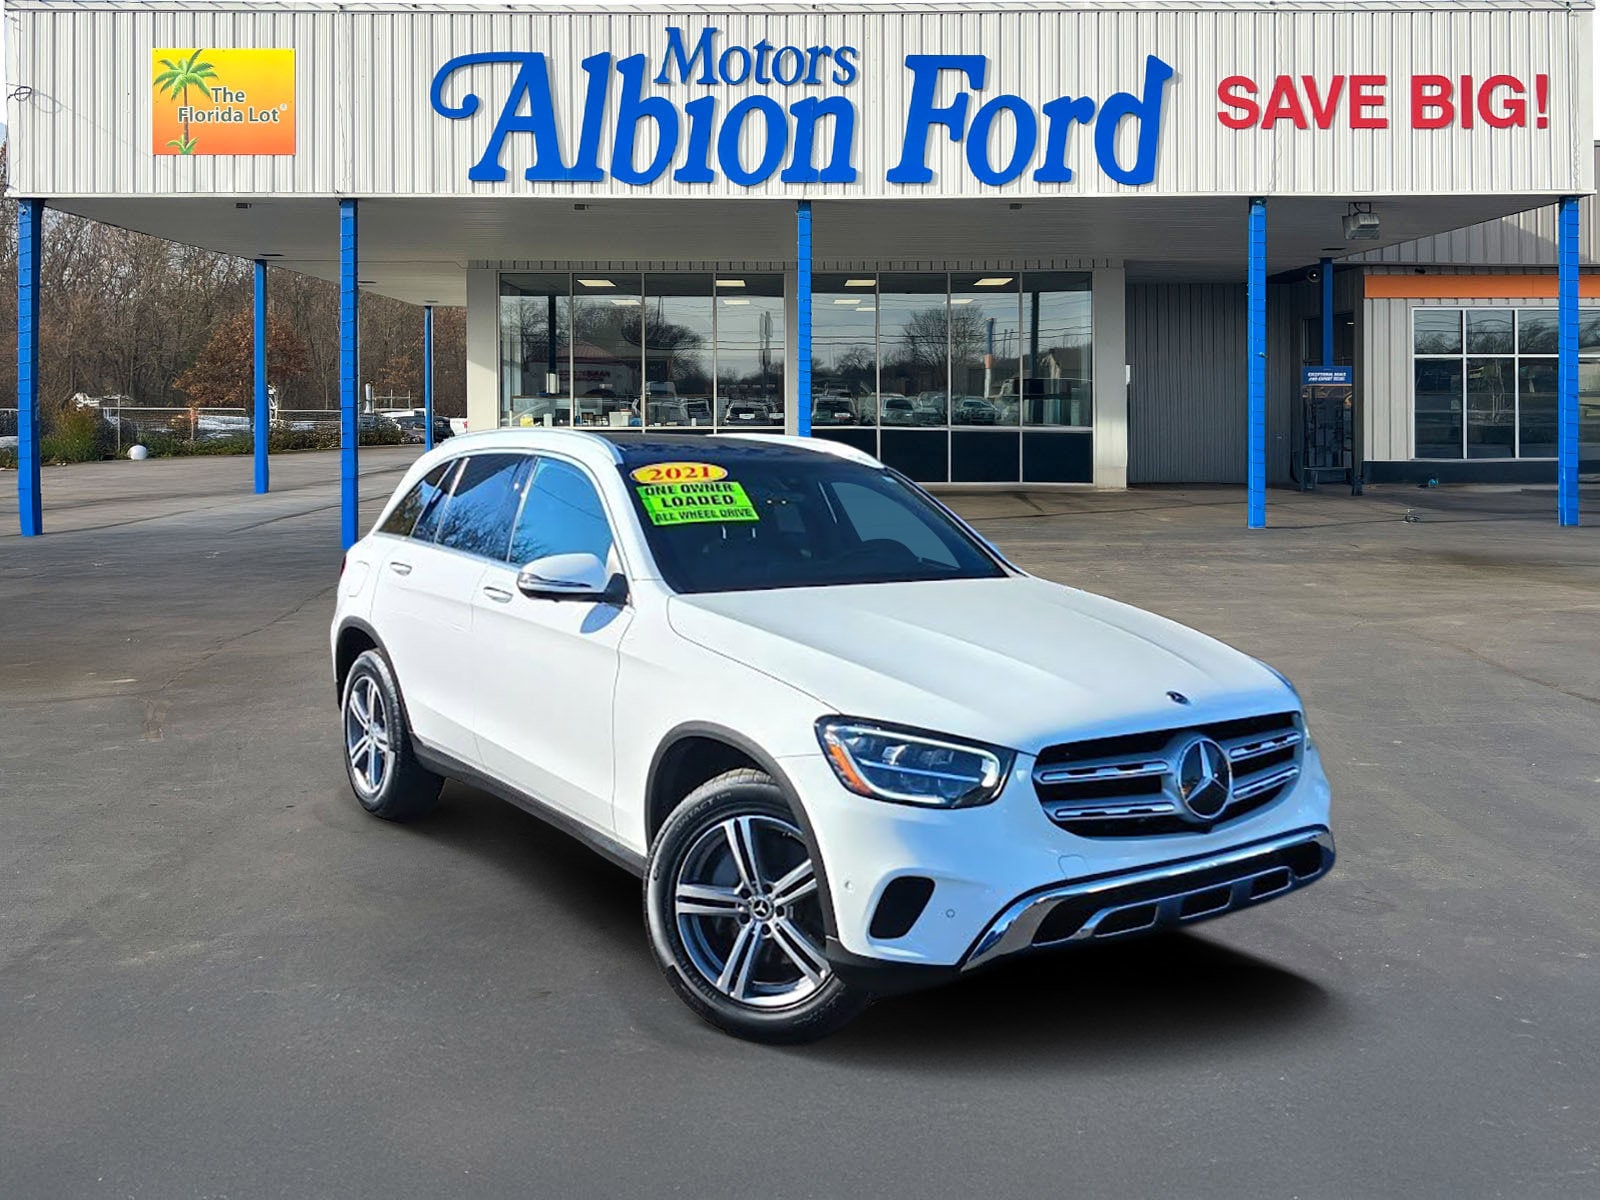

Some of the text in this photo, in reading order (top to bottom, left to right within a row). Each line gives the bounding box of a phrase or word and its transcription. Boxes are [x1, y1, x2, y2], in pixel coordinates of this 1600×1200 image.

[655, 27, 857, 85] Motors
[211, 87, 246, 103] The
[1217, 74, 1549, 129] SAVE BIG!
[178, 107, 243, 122] Florida
[430, 51, 1174, 186] Albion Ford
[648, 466, 711, 481] 2021
[645, 483, 734, 496] ONE OWNER
[661, 494, 735, 508] LOADED
[655, 507, 754, 523] ALL WHEEL DRIVE
